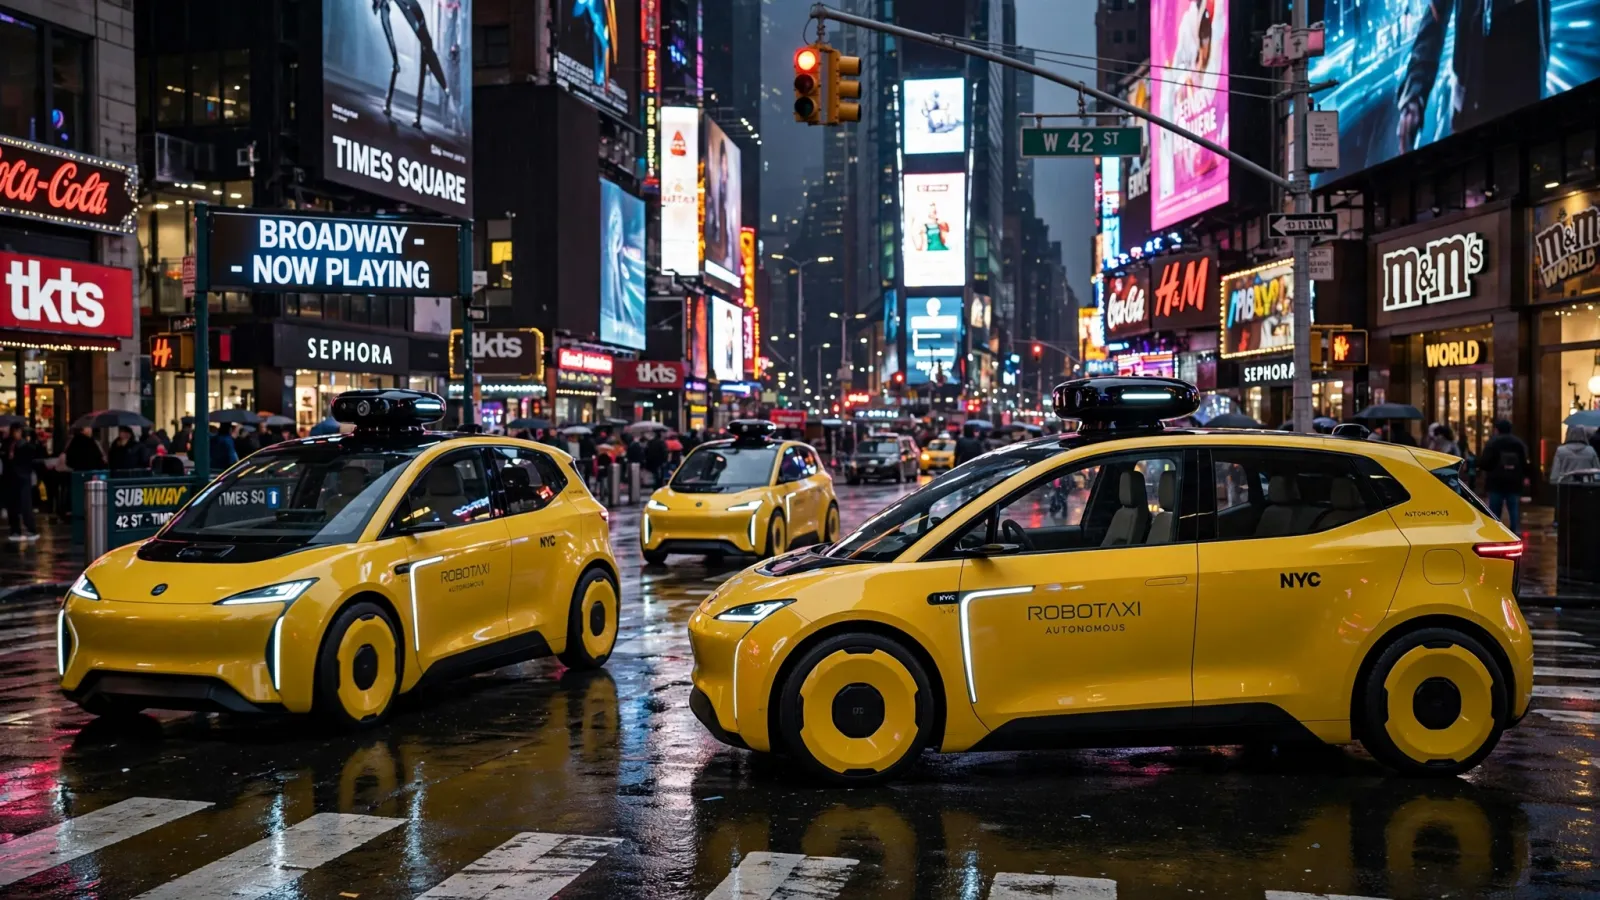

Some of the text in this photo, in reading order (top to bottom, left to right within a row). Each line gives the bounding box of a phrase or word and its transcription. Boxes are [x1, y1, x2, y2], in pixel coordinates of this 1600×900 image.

[1043, 131, 1120, 153] W 42 ST
[0, 147, 110, 215] oca-Cola
[332, 135, 393, 182] TIMES
[398, 157, 466, 204] SQUARE
[259, 219, 408, 254] BROADWAY
[253, 254, 318, 285] NOW
[325, 257, 430, 289] PLAYING
[1543, 248, 1596, 289] WORLD
[6, 260, 105, 328] tkts
[1154, 257, 1209, 317] H&M
[307, 337, 393, 365] SEPHORA
[472, 332, 522, 358] tkts
[1426, 340, 1480, 368] WORLD
[636, 363, 677, 383] tkts
[1244, 362, 1296, 382] SEPHORA
[250, 489, 265, 505] SQ
[116, 514, 129, 528] 42
[131, 513, 143, 528] ST
[540, 535, 556, 548] NYC
[440, 562, 490, 584] ROBOTAXI
[1280, 571, 1321, 588] NYC
[1027, 601, 1141, 621] ROBOTAXI
[1045, 623, 1125, 635] AUTONOMOUS
